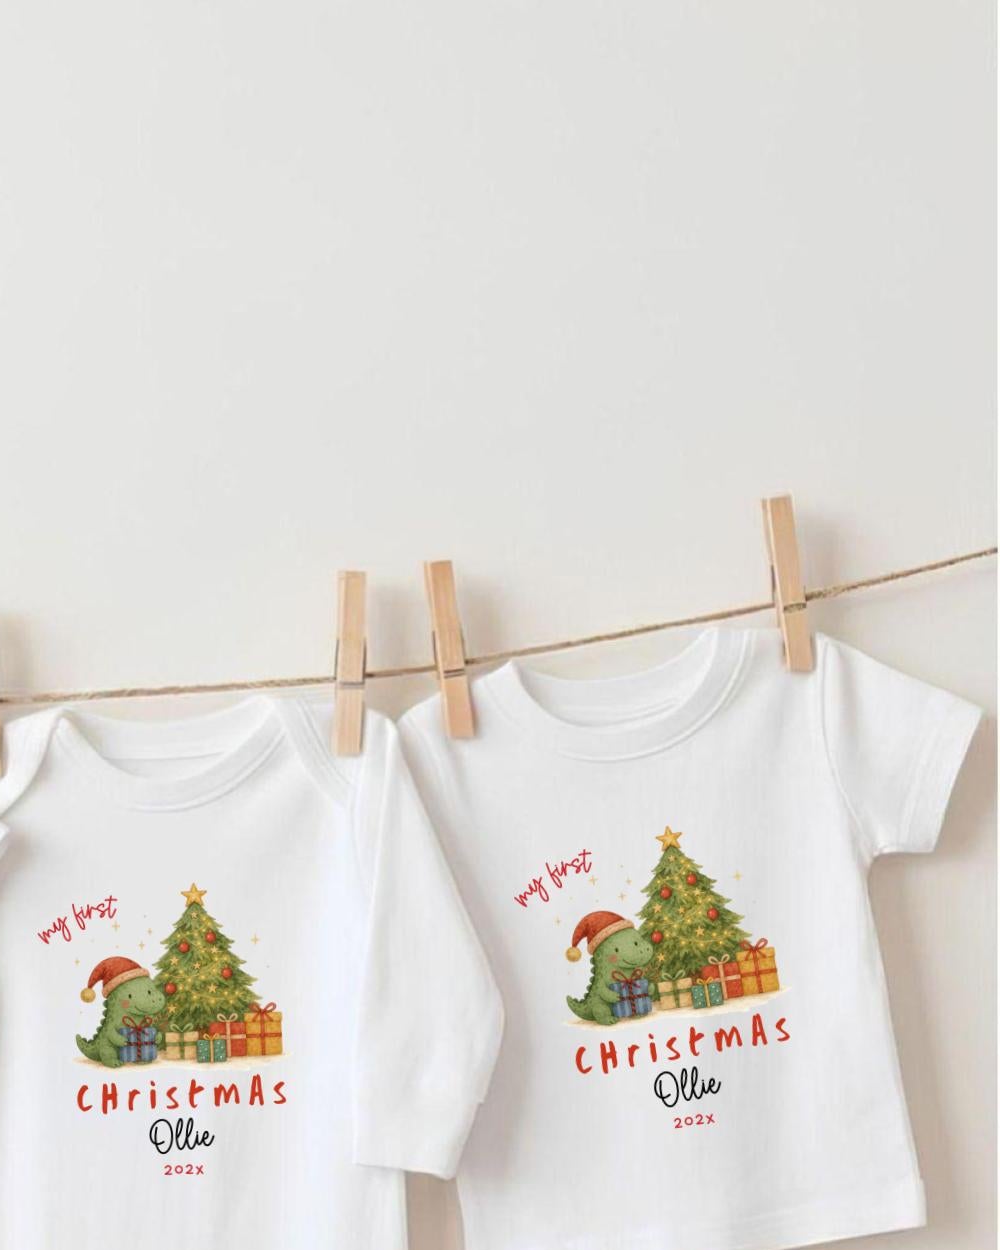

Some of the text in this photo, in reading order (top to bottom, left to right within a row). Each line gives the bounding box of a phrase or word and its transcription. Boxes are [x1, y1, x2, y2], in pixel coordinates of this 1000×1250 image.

[513, 848, 593, 908] my first
[37, 895, 118, 945] my first
[653, 1065, 722, 1108] Ollie
[148, 1117, 216, 1155] Ollie
